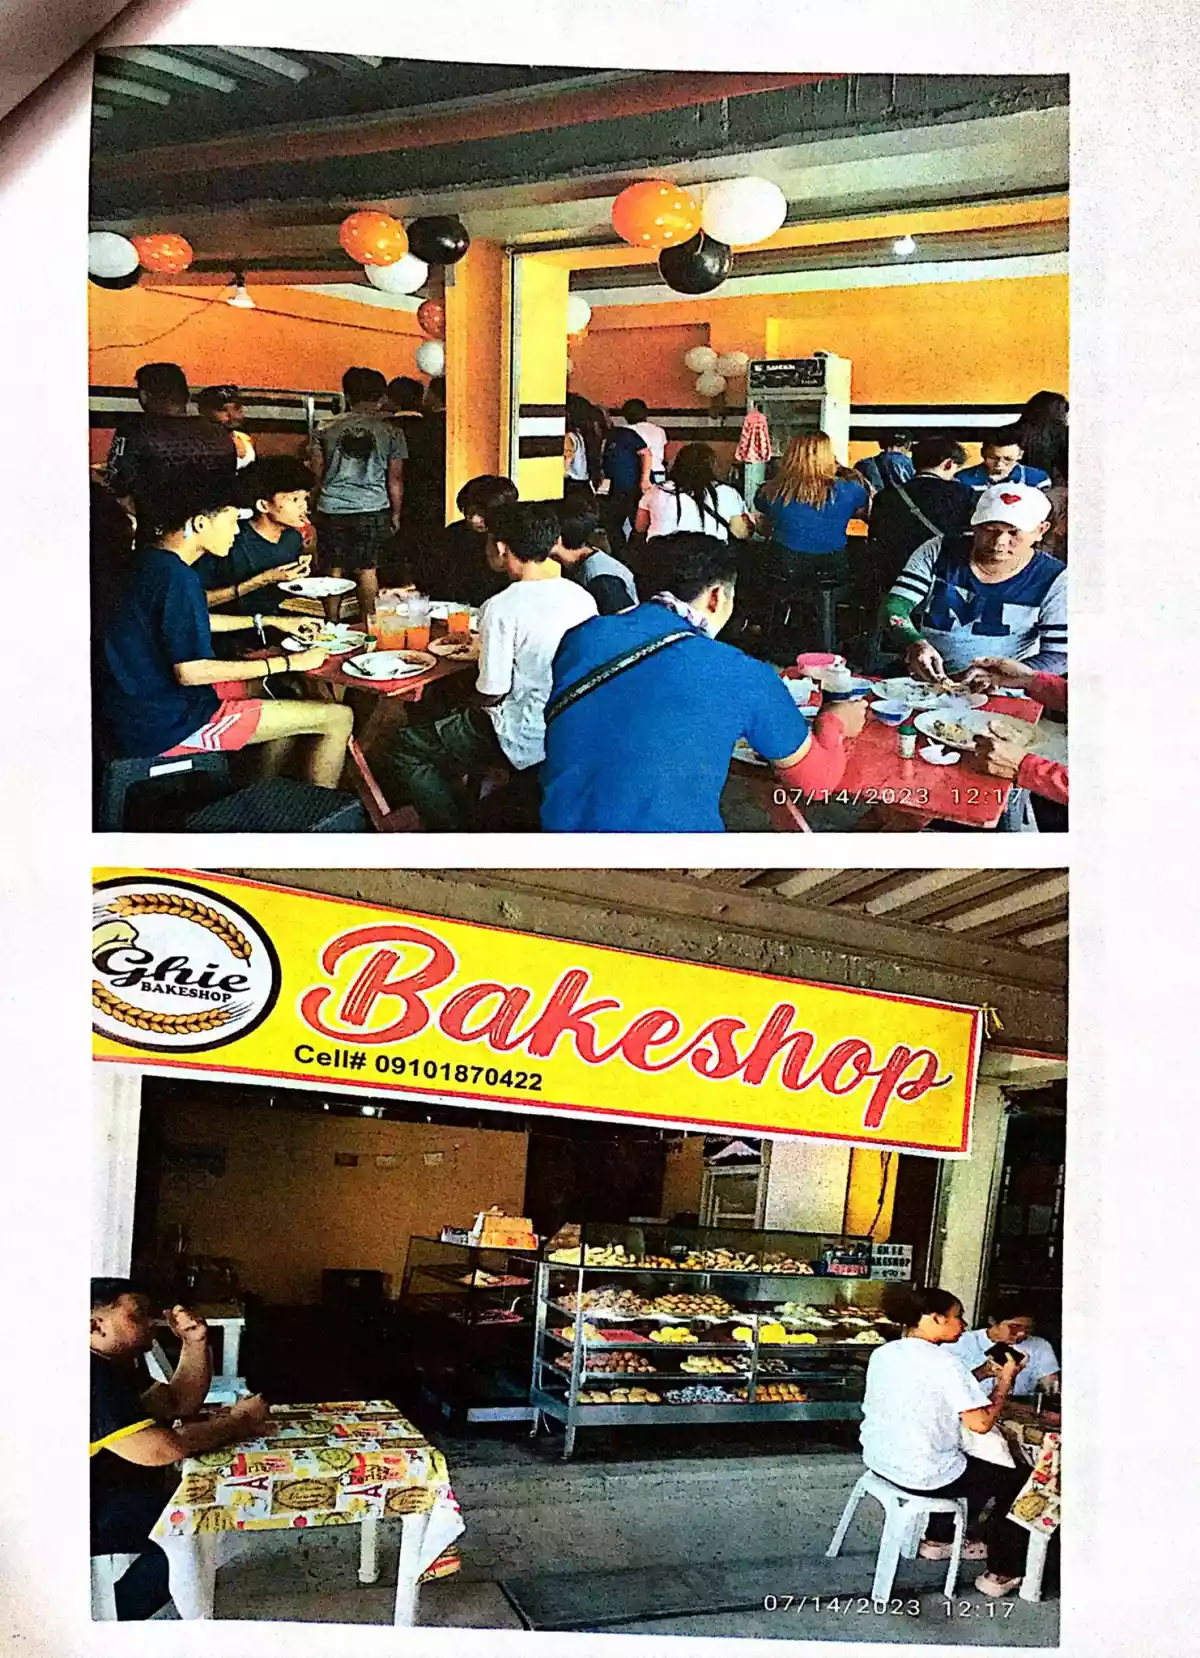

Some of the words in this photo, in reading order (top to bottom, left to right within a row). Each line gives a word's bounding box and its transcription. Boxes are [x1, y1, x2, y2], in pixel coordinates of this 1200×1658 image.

[92, 946, 251, 993] Ghie
[140, 981, 232, 1003] BAKESHOP
[300, 924, 952, 1128] Bakeshop
[294, 1044, 366, 1070] Cell#
[375, 1054, 543, 1091] 09101870422
